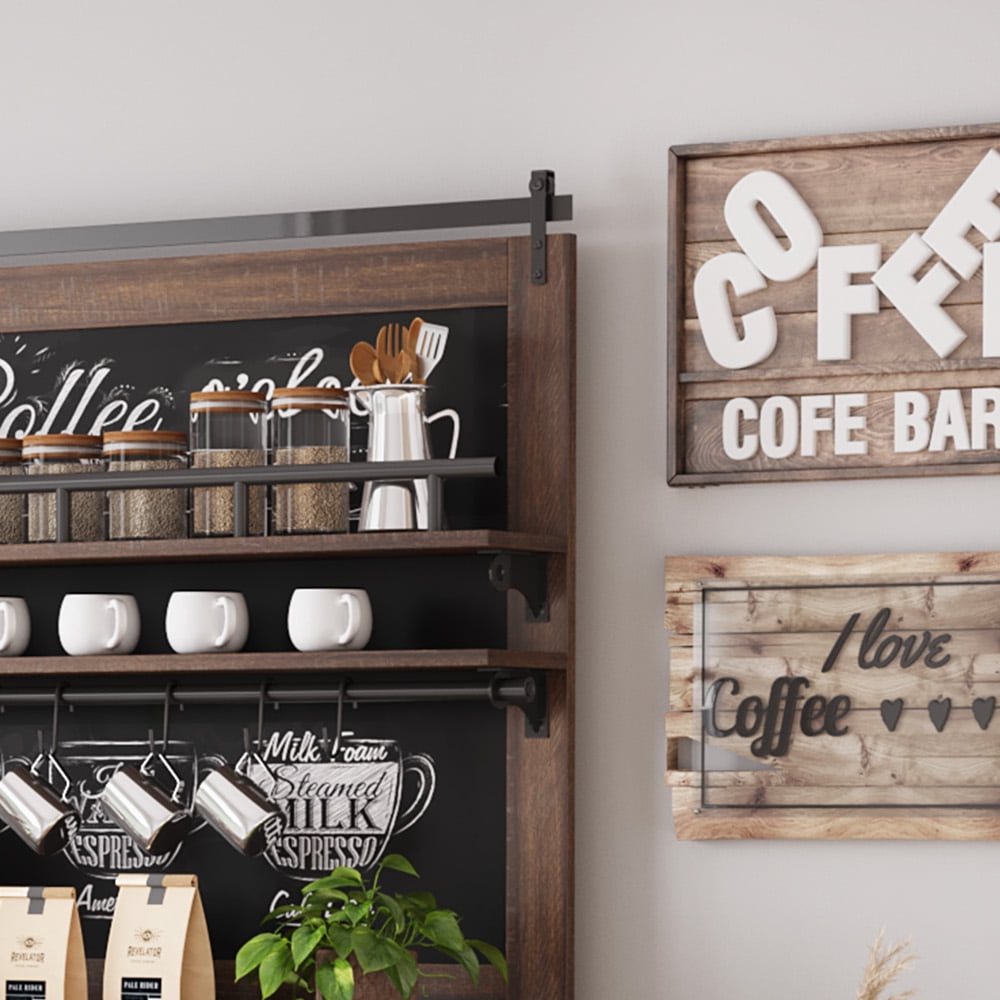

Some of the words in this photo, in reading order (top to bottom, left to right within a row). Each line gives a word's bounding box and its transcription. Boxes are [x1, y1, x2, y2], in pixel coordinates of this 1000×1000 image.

[694, 148, 1000, 370] COFFE
[722, 395, 868, 461] COFE
[894, 387, 1000, 453] BAR
[857, 607, 952, 670] love
[701, 675, 851, 758] Coffee
[262, 730, 321, 762] Milk
[270, 763, 388, 800] Steamed
[10, 951, 45, 963] REVELATOR
[127, 945, 162, 958] REVELATOR
[7, 983, 22, 992] PALE
[24, 983, 43, 993] RIDER
[123, 981, 138, 990] PALE
[139, 981, 159, 990] RIDER
